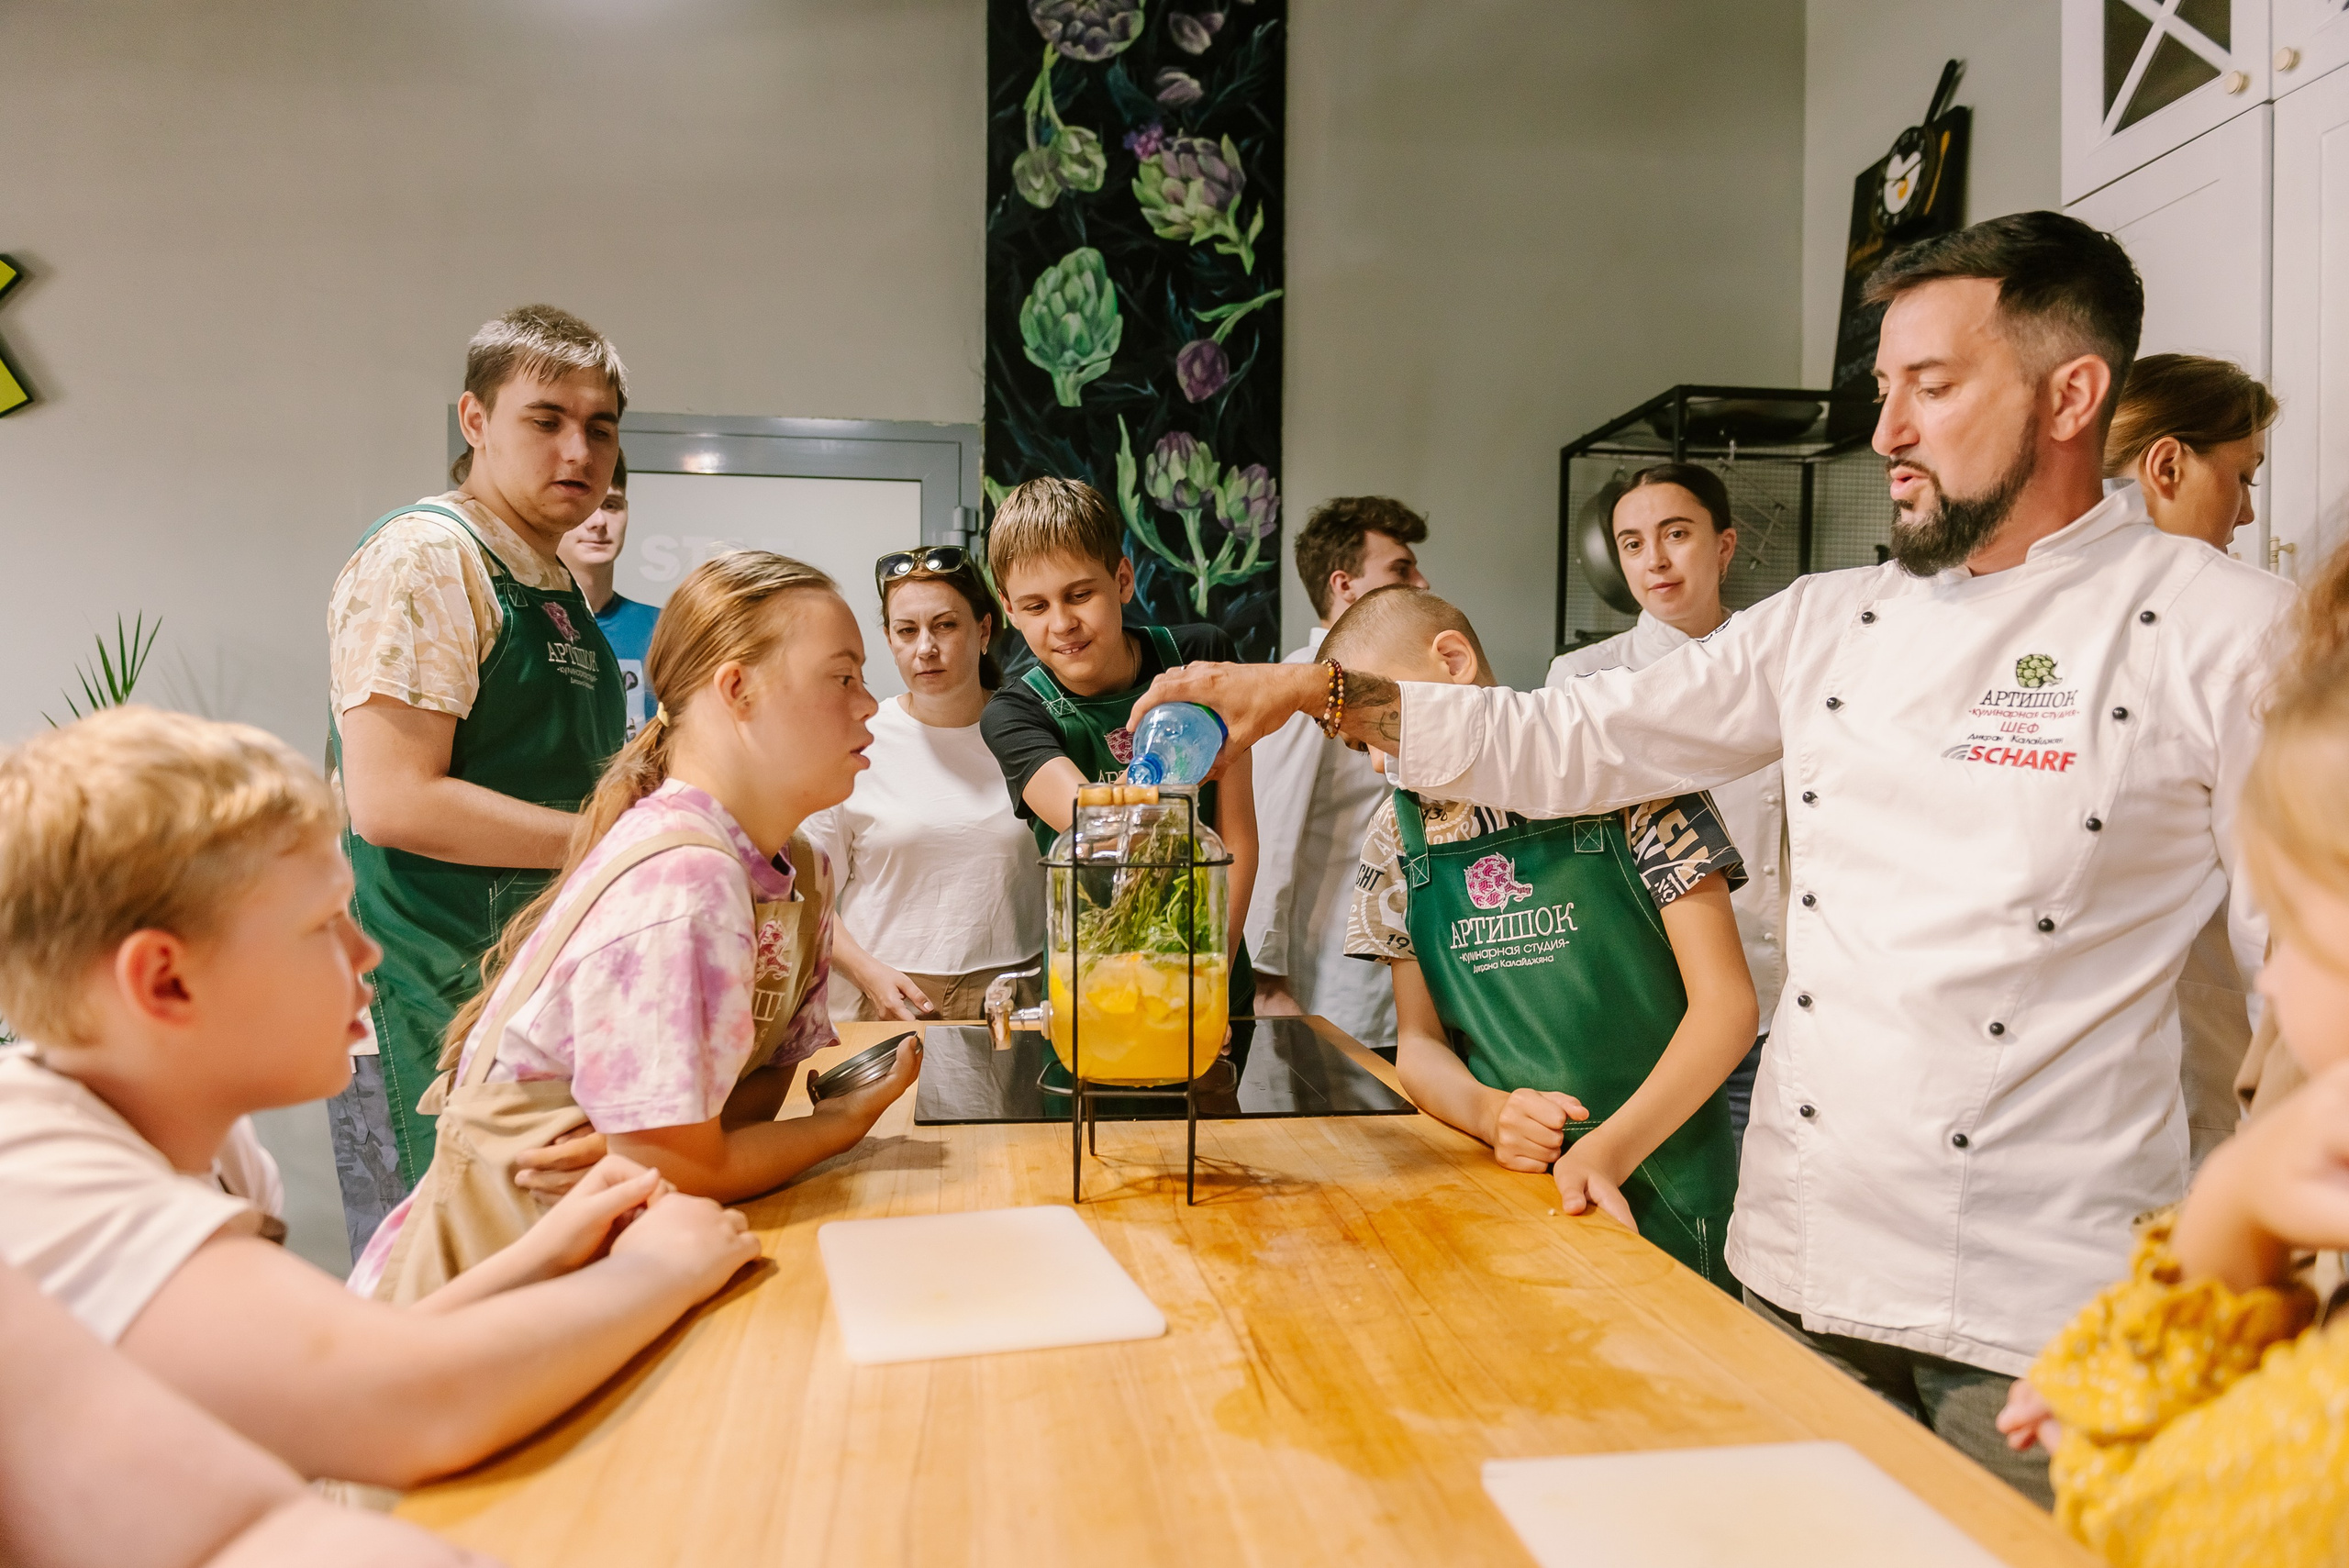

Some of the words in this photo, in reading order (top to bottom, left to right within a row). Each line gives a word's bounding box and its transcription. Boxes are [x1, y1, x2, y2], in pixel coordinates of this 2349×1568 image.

[1979, 689, 2078, 708] АРТИШОК
[1999, 721, 2040, 734] ШЕФ
[1966, 745, 2078, 773] SCHARF
[1450, 902, 1578, 949] АРТИШОК
[1499, 955, 1554, 968] Калайджяна
